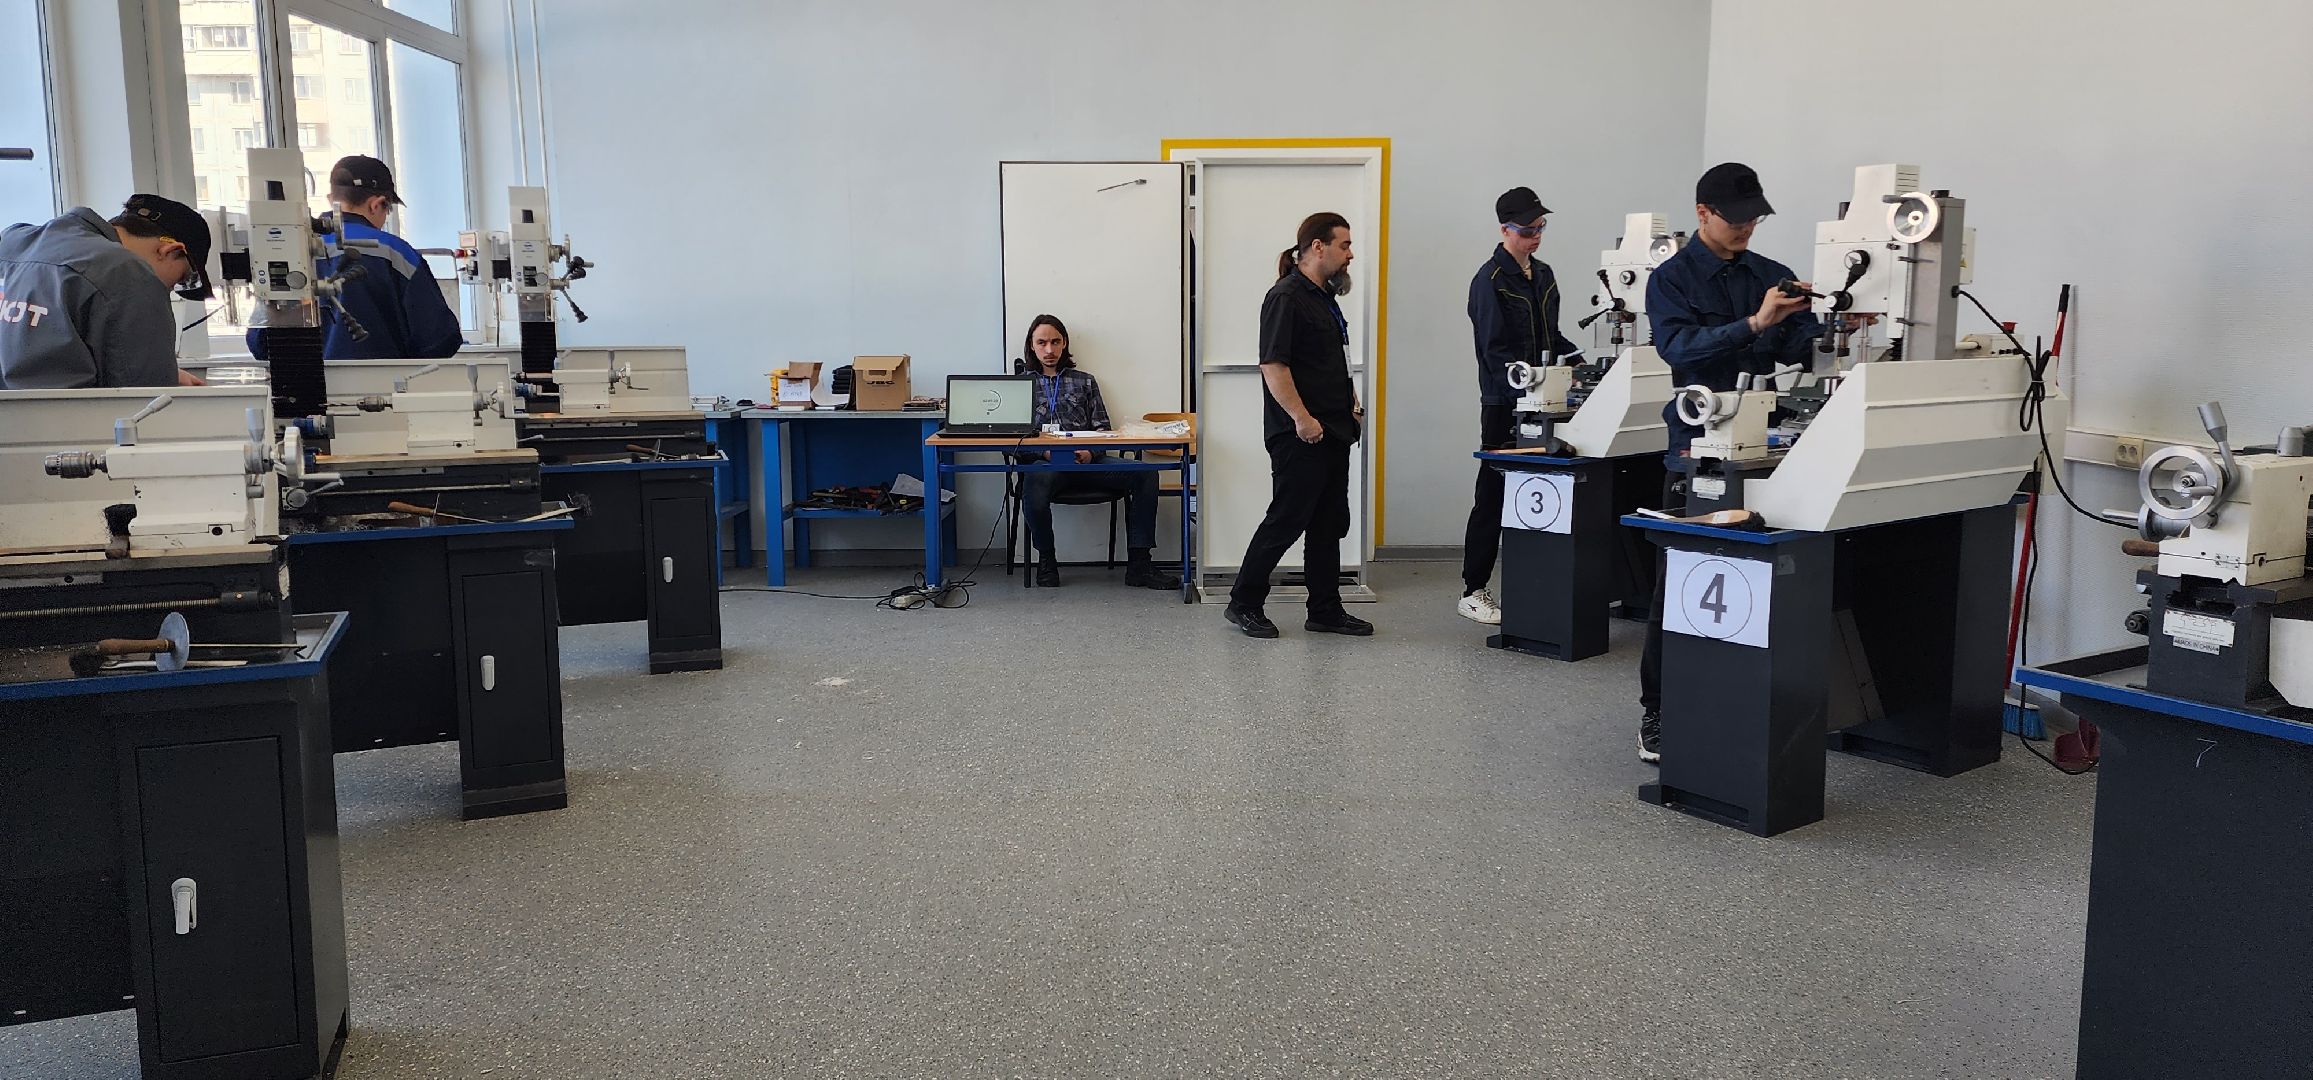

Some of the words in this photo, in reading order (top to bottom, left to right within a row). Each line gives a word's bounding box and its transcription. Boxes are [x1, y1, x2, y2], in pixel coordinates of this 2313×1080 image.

[0, 300, 48, 327] ЮТ
[1531, 491, 1543, 514] 3
[1700, 573, 1727, 623] 4
[2177, 638, 2192, 647] MADE
[2199, 643, 2216, 652] CHINA
[2196, 738, 2217, 768] 7
